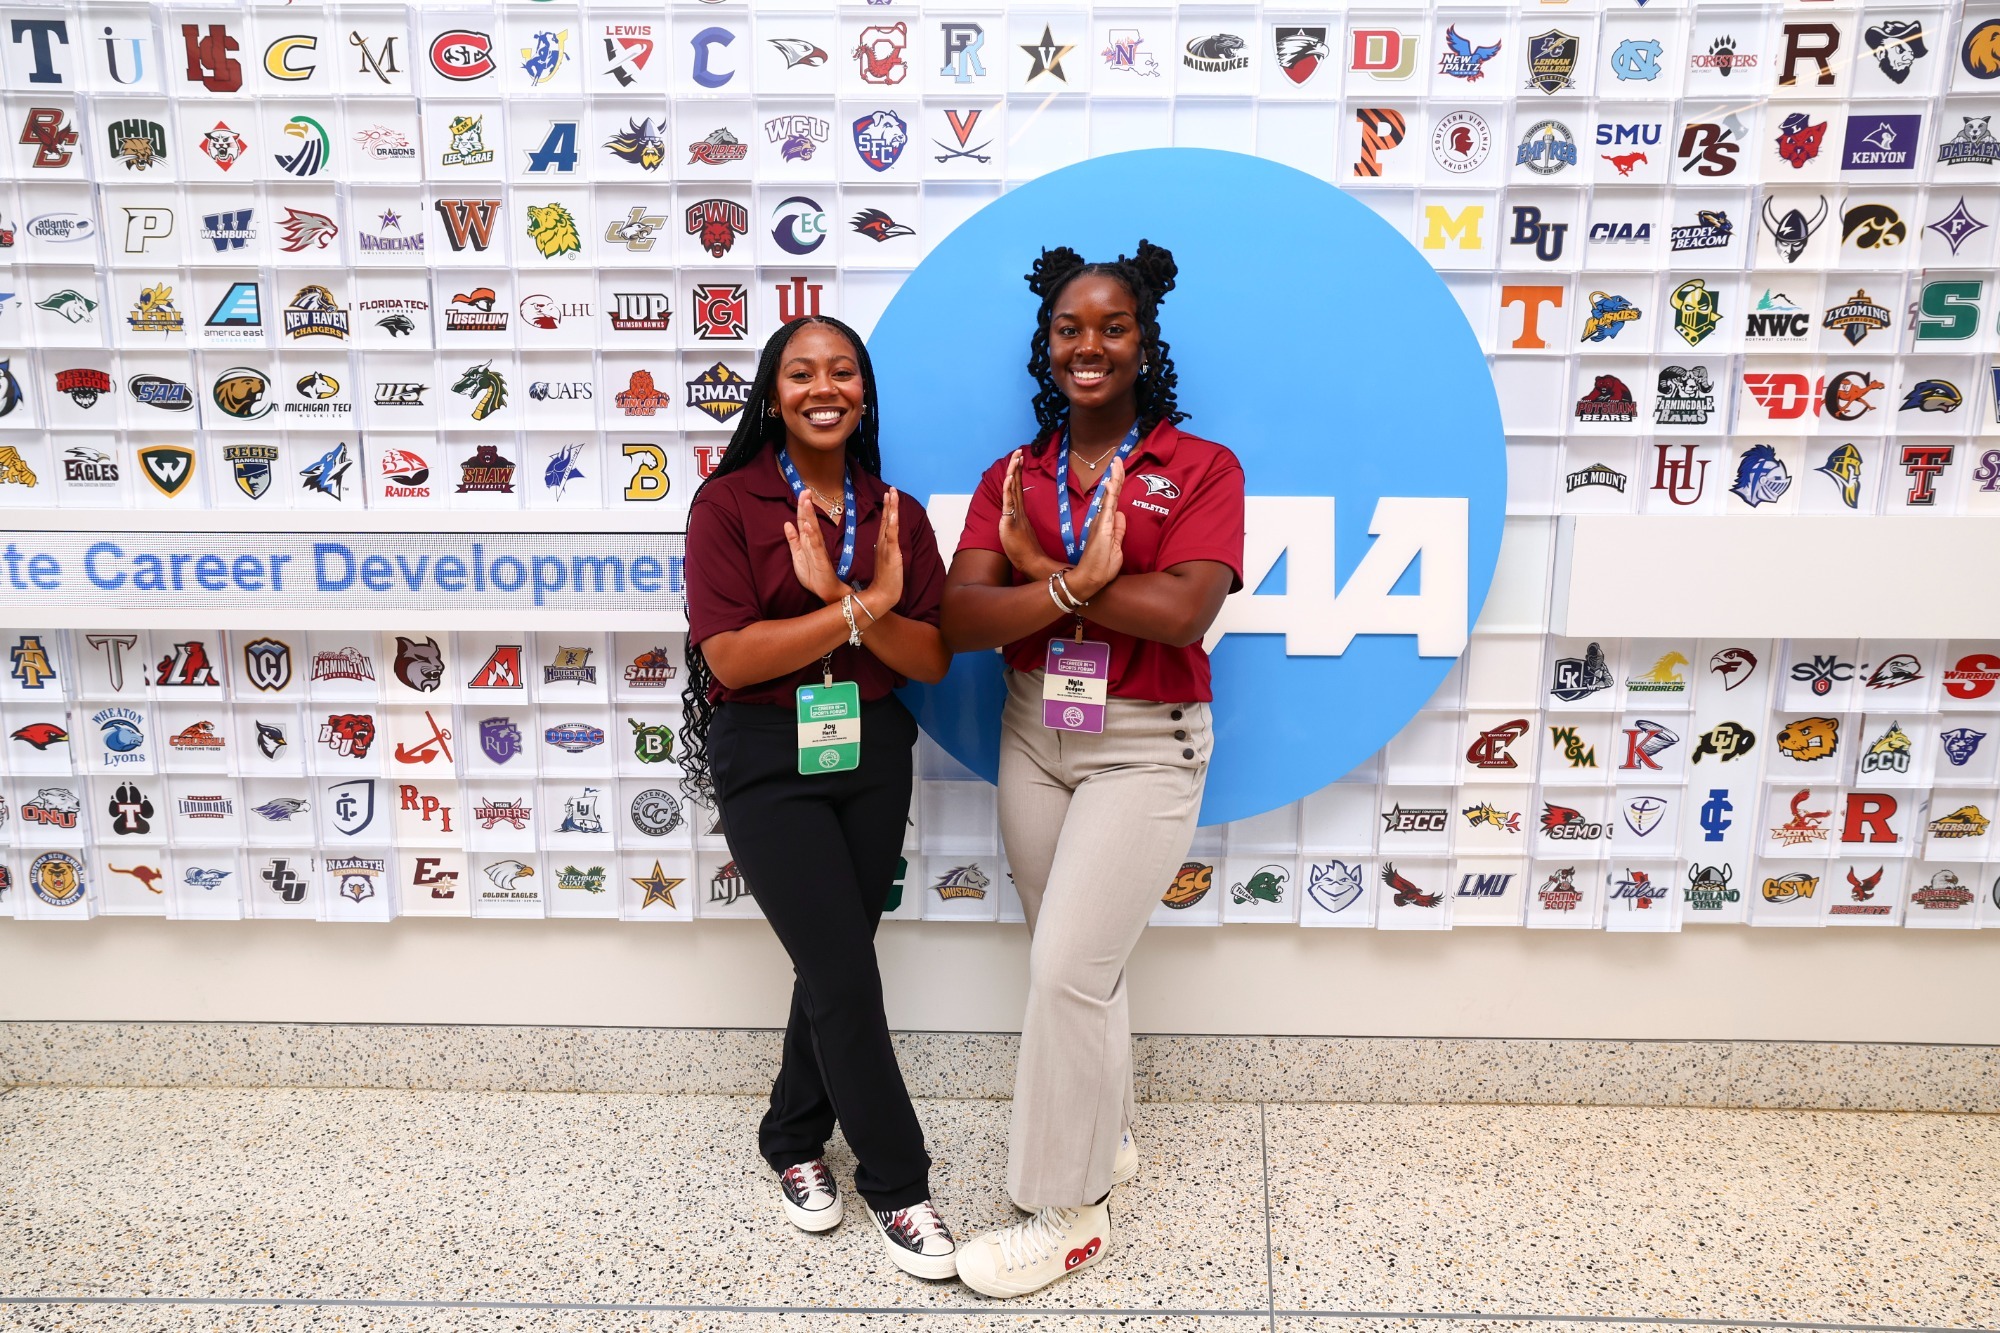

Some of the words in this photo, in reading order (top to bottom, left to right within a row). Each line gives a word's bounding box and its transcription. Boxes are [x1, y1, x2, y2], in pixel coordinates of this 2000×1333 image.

[606, 26, 651, 36] LEWIS
[11, 20, 69, 83] T
[264, 35, 317, 81] C
[690, 27, 735, 88] C
[1444, 53, 1471, 63] NEW
[1778, 22, 1841, 87] R
[1183, 55, 1249, 73] MILWAUKEE
[1443, 62, 1481, 73] PALTZ
[1533, 65, 1570, 73] COLLEGE
[1534, 58, 1570, 66] LEHMAN
[1691, 55, 1757, 68] FORESTERS
[765, 115, 829, 143] WCU
[1597, 124, 1661, 145] SMU
[108, 119, 167, 158] OHIO
[1354, 108, 1406, 177] P
[377, 148, 416, 156] DRAGONS
[688, 142, 748, 165] RIDER
[858, 133, 893, 164] SFC
[1942, 141, 2000, 159] DAEMEN
[1442, 158, 1479, 170] KNIGHTS
[1852, 152, 1906, 164] KENYON
[1951, 156, 1992, 164] UNIVERSITY
[37, 218, 75, 228] atlantic
[687, 200, 748, 232] CWU
[35, 226, 71, 238] hockey
[120, 207, 173, 253] P
[435, 199, 502, 251] W
[1423, 205, 1484, 250] M
[1589, 223, 1651, 242] CIAA
[201, 230, 256, 240] WASHBURN
[1511, 206, 1567, 262] BU
[1675, 235, 1727, 249] BEACOM
[360, 299, 403, 311] FLORIDA
[617, 293, 669, 320] IUP
[708, 299, 732, 325] G
[1828, 304, 1888, 322] LYCOMING
[1916, 281, 1983, 341] S
[285, 311, 310, 329] NEW
[313, 311, 347, 330] HAVEN
[447, 309, 507, 325] TUSCULUM
[1501, 286, 1563, 348] T
[1584, 310, 1640, 337] MUSKIES
[1746, 314, 1810, 337] NWC
[243, 329, 264, 337] east
[294, 327, 343, 339] CHARGERS
[56, 368, 111, 381] WESTERN
[57, 378, 110, 392] OREGON
[139, 384, 186, 402] SAA
[547, 382, 592, 400] UAFS
[690, 384, 752, 402] RMAC
[285, 403, 330, 412] MICHIGAN
[616, 399, 668, 408] LINCOLN
[625, 407, 656, 416] LIONS
[1576, 401, 1637, 416] POTSDAM
[1656, 397, 1713, 410] FARMINGDALE
[1582, 413, 1632, 422] BEARS
[1659, 409, 1706, 423] RAMS
[224, 446, 278, 460] REGIS
[65, 459, 119, 481] EAGLES
[462, 466, 513, 484] SHAW
[622, 444, 670, 501] B
[1567, 474, 1588, 491] THE
[1590, 471, 1626, 491] MOUNT
[385, 485, 430, 497] RAIDERS
[1131, 499, 1170, 516] ATHLETES
[84, 541, 291, 592] Career
[312, 656, 376, 681] FARMINGTON
[546, 667, 595, 681] HOUGHTON
[624, 665, 676, 680] SALEM
[1068, 679, 1083, 687] Nyla
[92, 707, 144, 725] WHEATON
[545, 726, 604, 745] ODAC
[823, 723, 836, 732] Joy
[318, 722, 354, 757] BSU
[485, 736, 508, 756] RU
[646, 735, 663, 753] B
[1549, 726, 1598, 768] W&M
[104, 752, 145, 768] Lyons
[1862, 752, 1911, 773] CCU
[179, 799, 233, 815] LANDMARK
[399, 784, 454, 832] RPI
[633, 790, 677, 811] CENTENNIAL
[22, 804, 77, 828] ONU
[119, 803, 141, 828] T
[476, 807, 531, 821] RAIDERS
[642, 802, 668, 825] CC
[1842, 793, 1898, 843] R
[1398, 814, 1446, 831] ECC
[1928, 822, 1978, 832] EMERSON
[1552, 823, 1602, 840] SEMO
[1771, 829, 1829, 841] CHESTNUT
[1934, 831, 1965, 839] LIONS
[1783, 837, 1813, 847] HILL
[30, 856, 48, 884] WESTERN
[48, 852, 64, 861] NEW
[327, 859, 384, 872] NAZARETH
[263, 858, 307, 903] JCU
[560, 873, 606, 883] FITCHBURG
[562, 879, 586, 887] STATE
[1459, 872, 1514, 898] LMU
[941, 886, 984, 900] MUSTANGS
[1538, 891, 1584, 902] FIGHTING
[1610, 879, 1668, 901] Tulsa
[1684, 888, 1740, 904] LEVELAND
[1762, 877, 1819, 899] GSW
[1911, 889, 1974, 902] BRIDGEWATER
[39, 890, 82, 906] UNIVERSITY
[1544, 901, 1576, 911] SCOTS
[1692, 900, 1723, 910] STATE
[1925, 900, 1960, 909] EAGLES
